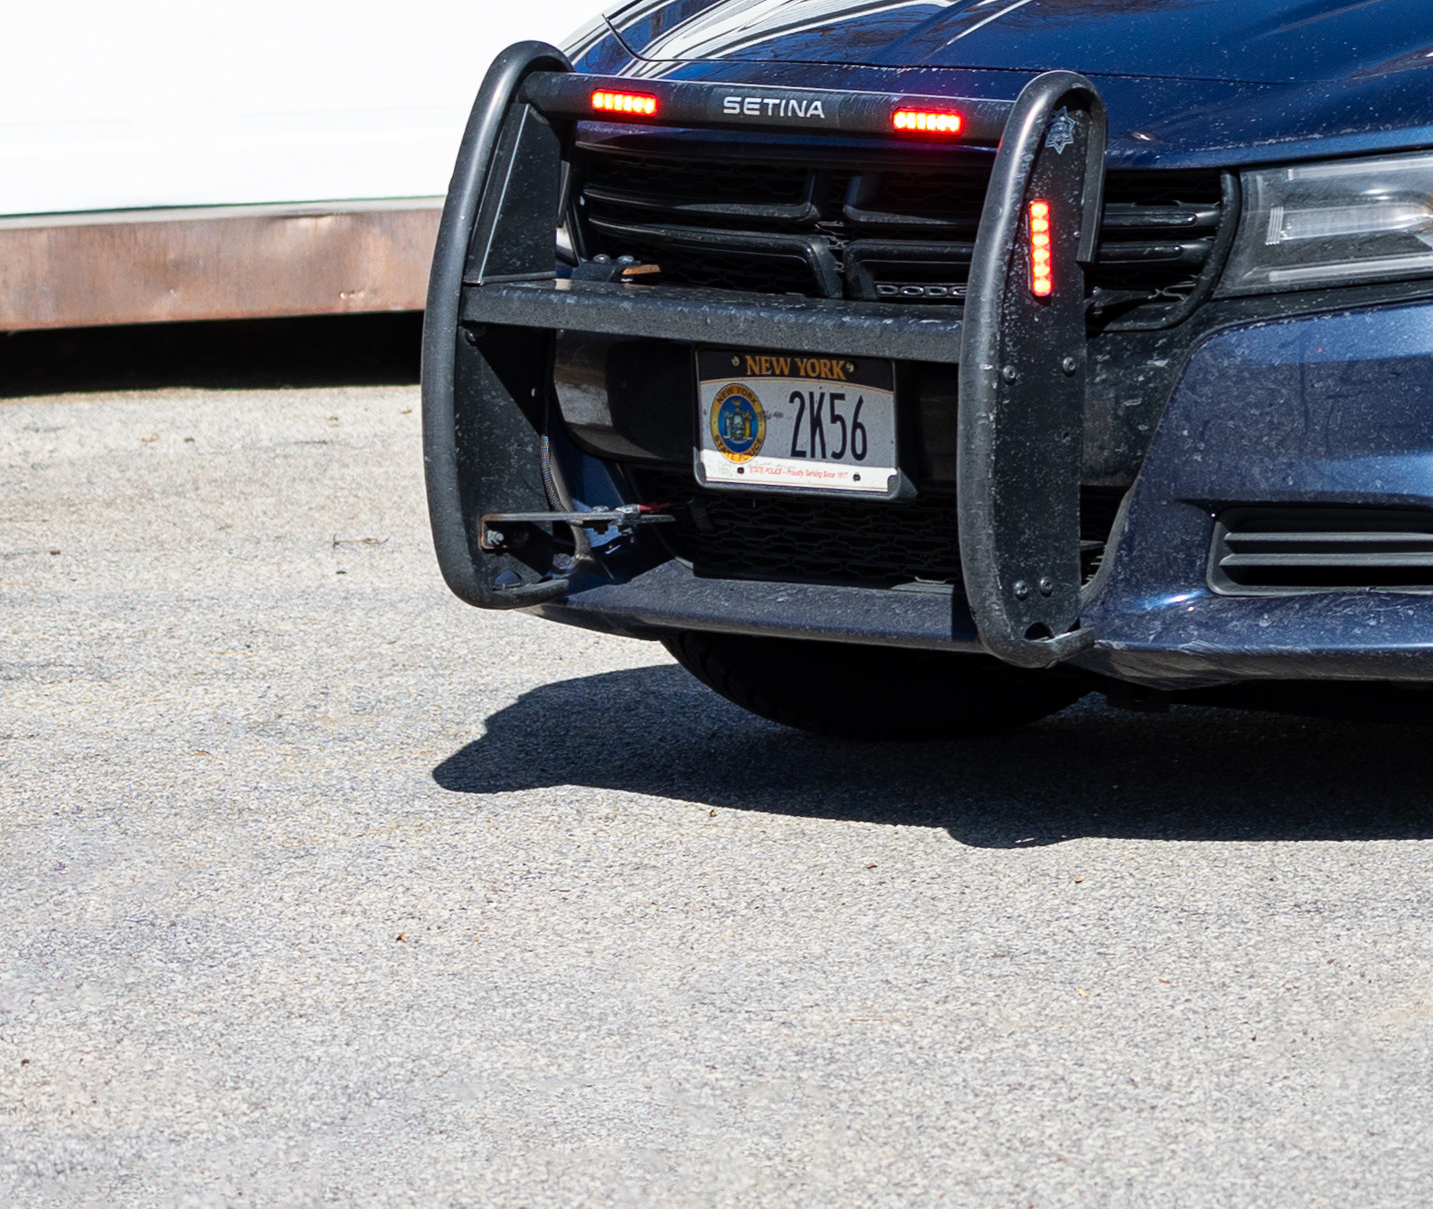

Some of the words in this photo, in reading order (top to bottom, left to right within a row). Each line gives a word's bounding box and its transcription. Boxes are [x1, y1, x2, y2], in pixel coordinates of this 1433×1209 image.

[723, 96, 825, 118] SETINA
[876, 284, 968, 296] DODG
[746, 355, 790, 375] NEW
[794, 357, 847, 380] YORK
[788, 390, 868, 461] 2K56
